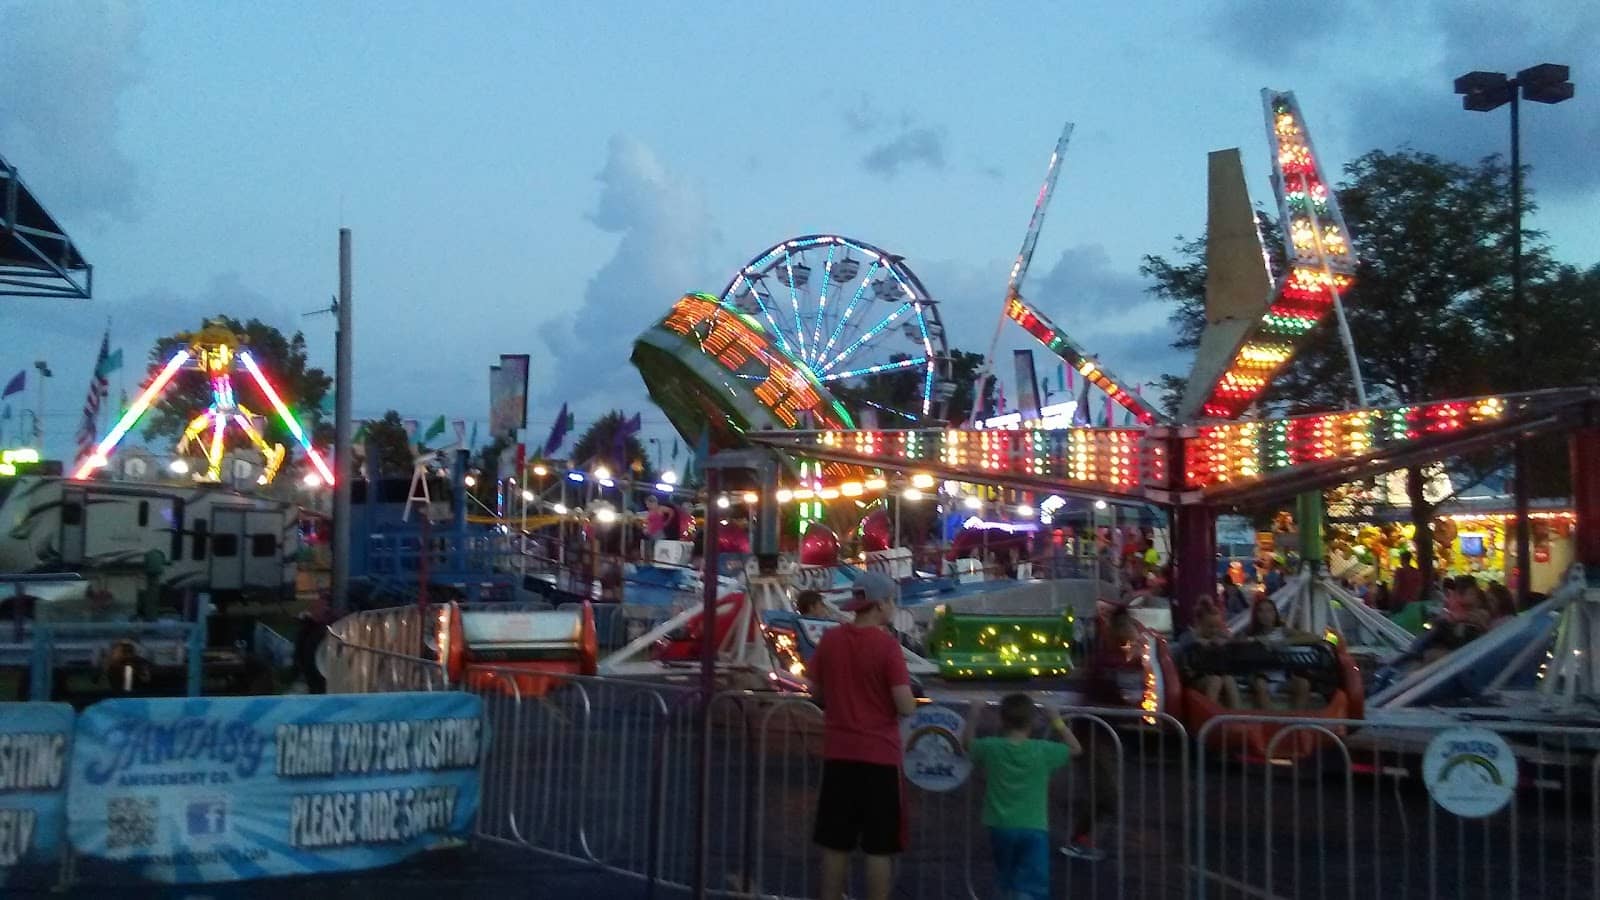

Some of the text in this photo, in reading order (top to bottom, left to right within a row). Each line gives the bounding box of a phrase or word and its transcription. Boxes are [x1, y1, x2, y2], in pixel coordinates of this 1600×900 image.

[276, 717, 480, 776] THANK YOU FOR VISITING
[118, 771, 206, 786] AMUSEMENT
[290, 783, 458, 847] PLEASE RIDE SAFELY
